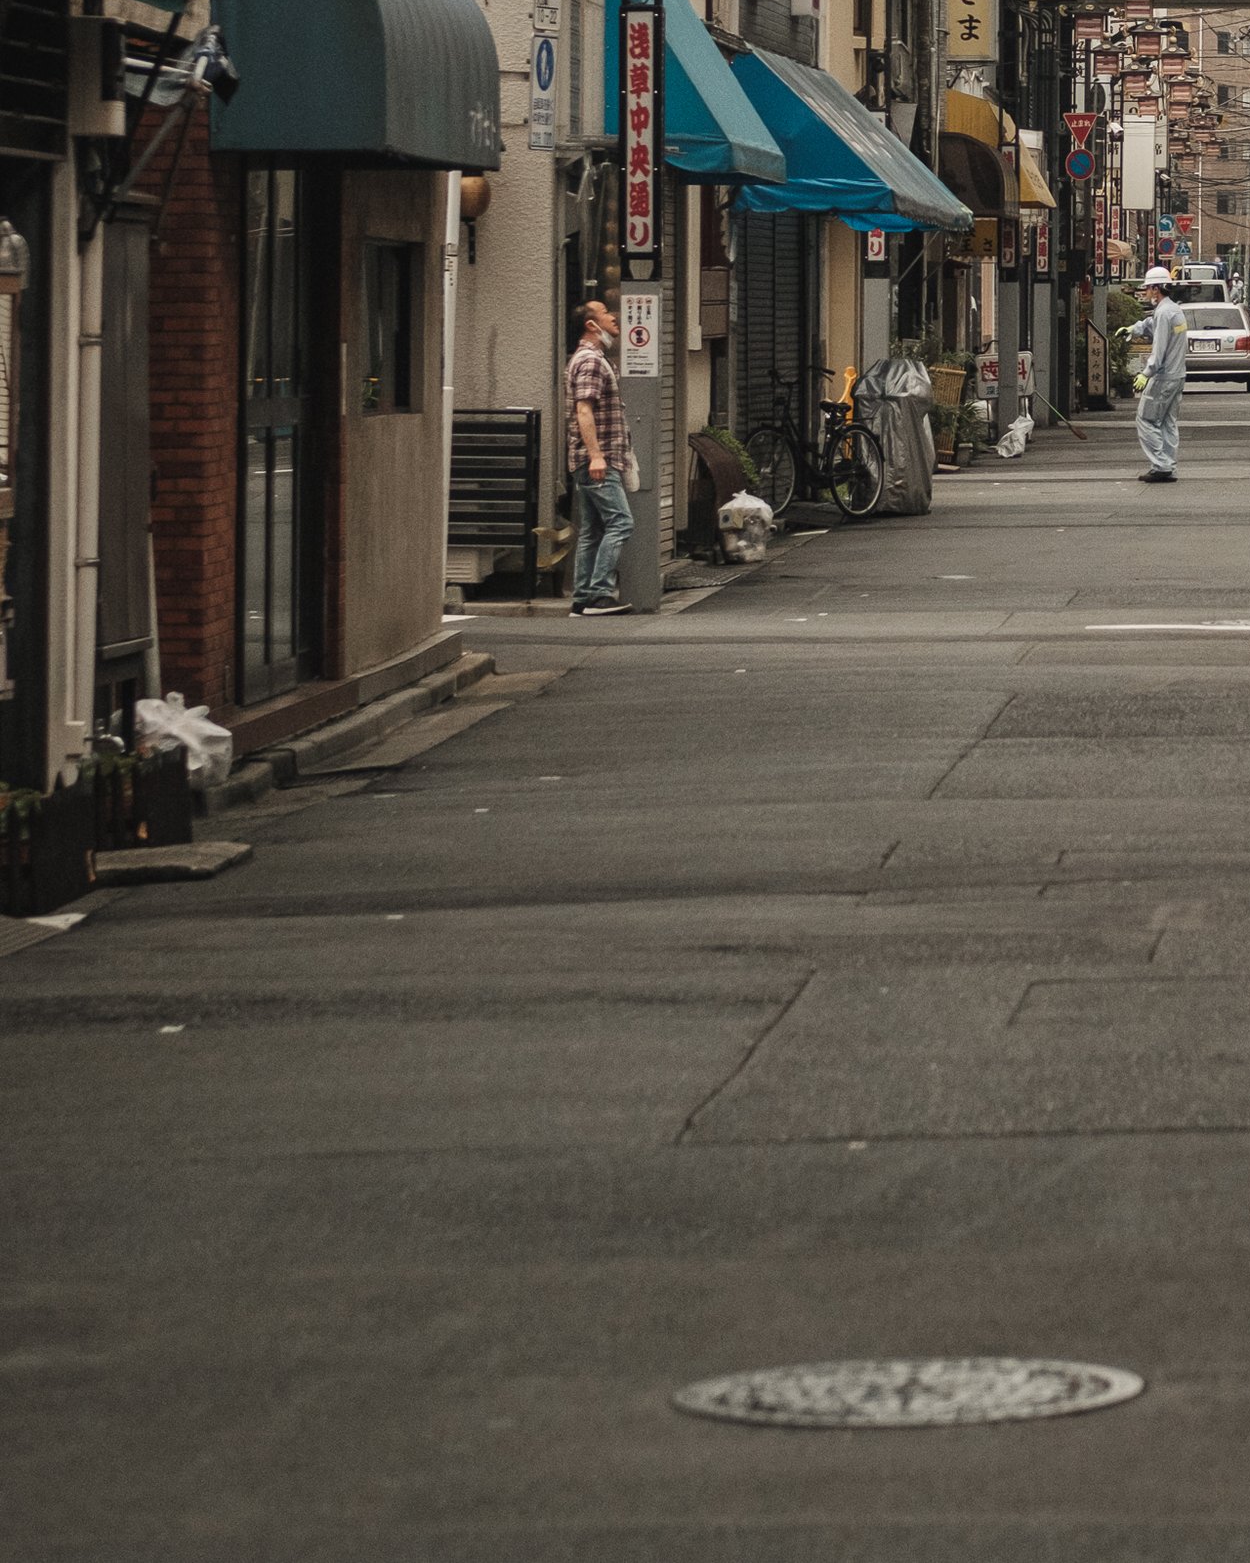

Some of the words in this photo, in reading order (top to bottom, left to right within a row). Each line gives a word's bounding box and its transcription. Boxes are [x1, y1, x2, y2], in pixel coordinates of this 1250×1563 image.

[629, 22, 650, 247] 浅草中央通り
